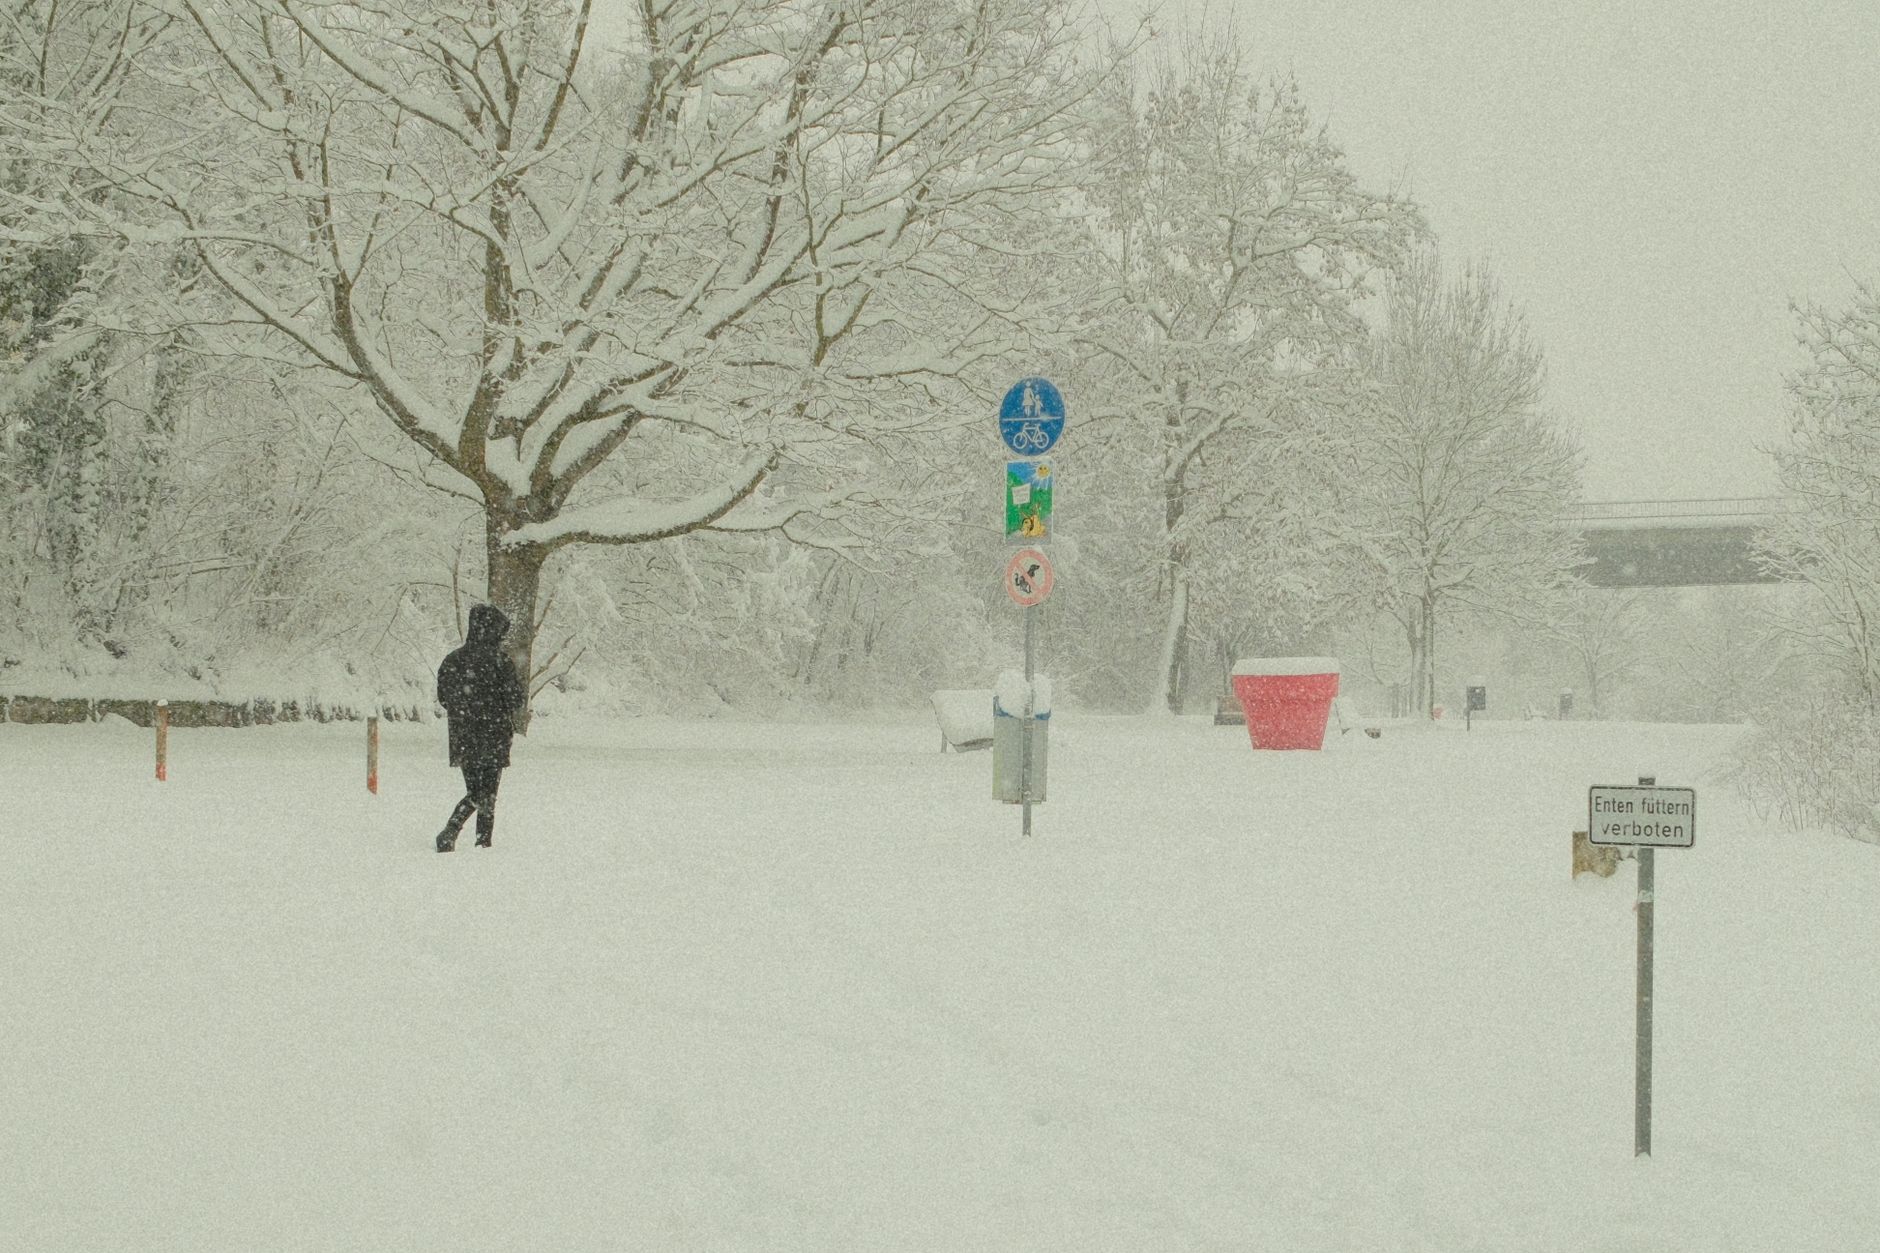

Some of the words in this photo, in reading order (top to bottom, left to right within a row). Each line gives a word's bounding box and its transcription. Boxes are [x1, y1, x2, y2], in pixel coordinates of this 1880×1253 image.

[1595, 796, 1633, 813] Enten
[1641, 797, 1689, 815] füttern
[1602, 820, 1683, 838] verboten
